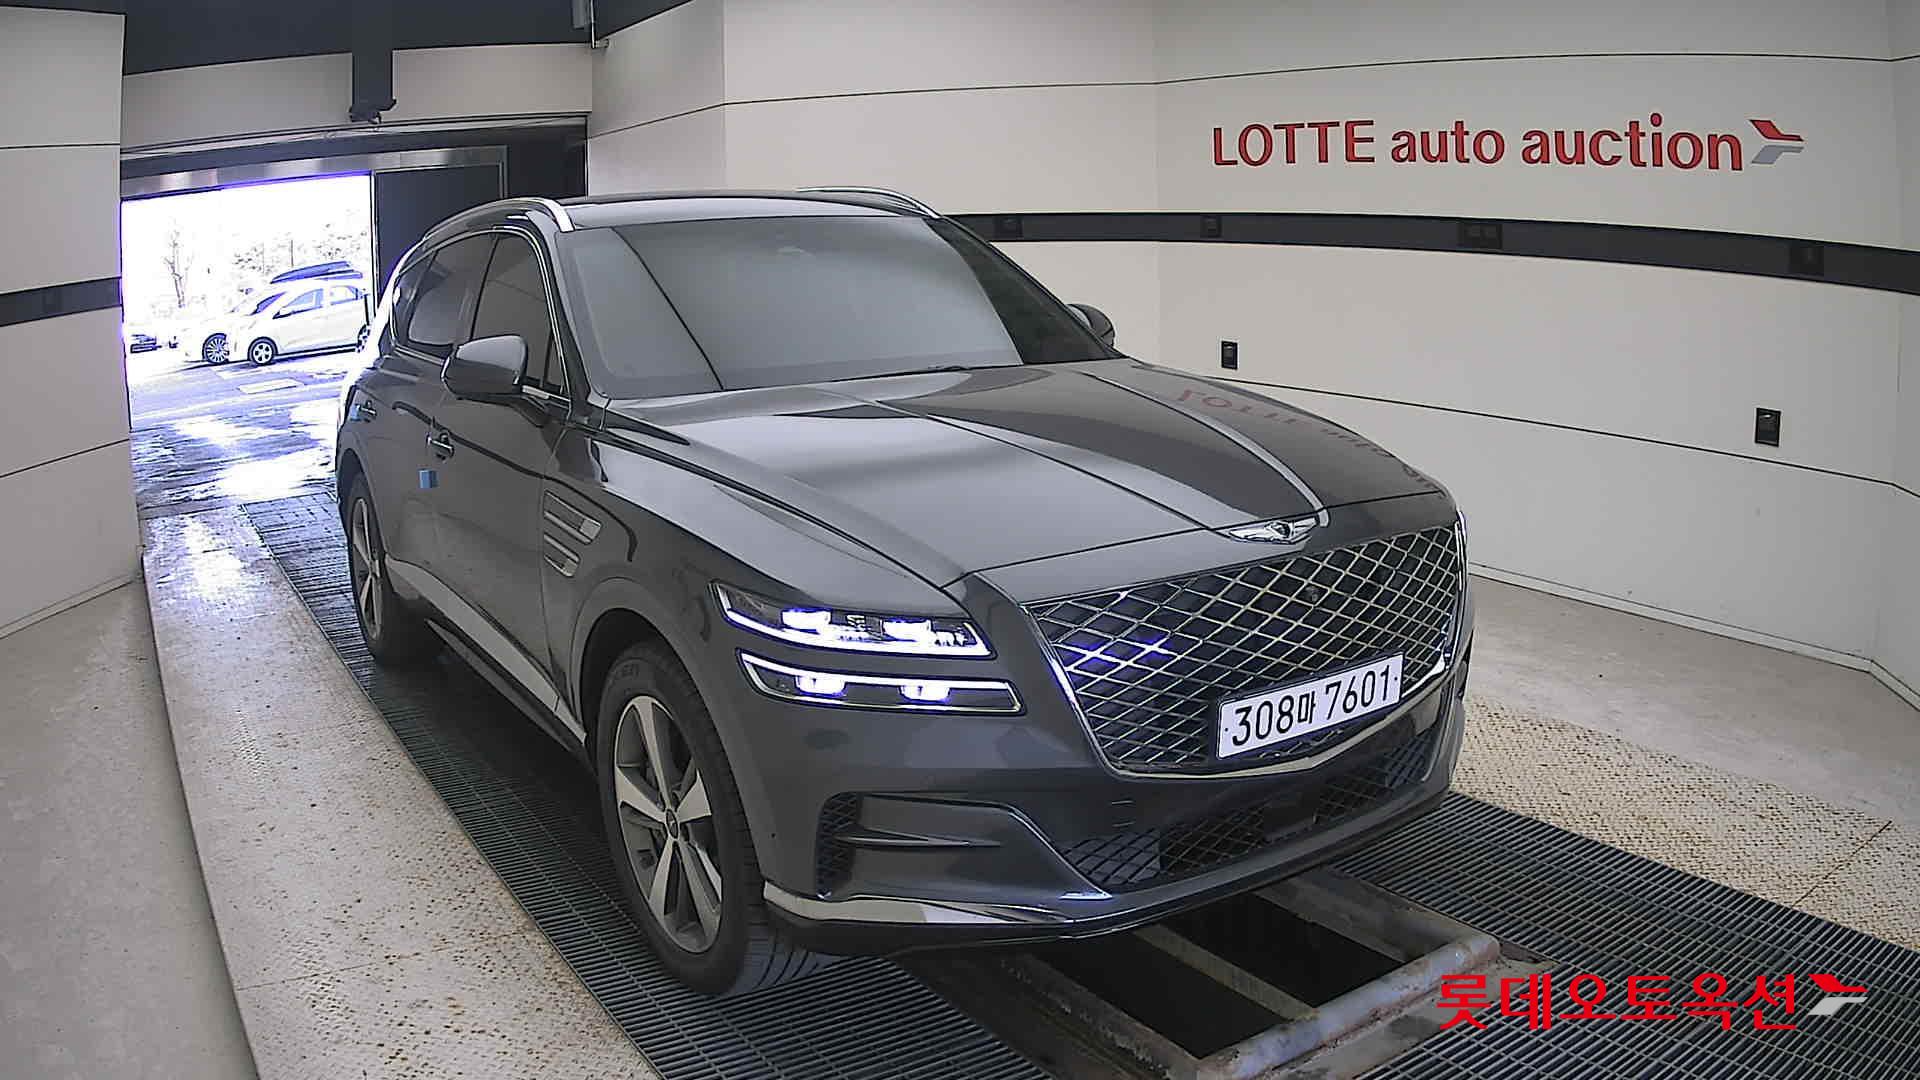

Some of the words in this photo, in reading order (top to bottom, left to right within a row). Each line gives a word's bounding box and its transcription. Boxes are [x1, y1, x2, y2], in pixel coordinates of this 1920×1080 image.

[1214, 120, 1375, 167] LOTTE
[1391, 121, 1506, 166] auto
[1521, 113, 1744, 171] auction
[1232, 690, 1316, 746] 308마
[1325, 664, 1390, 720] 7601
